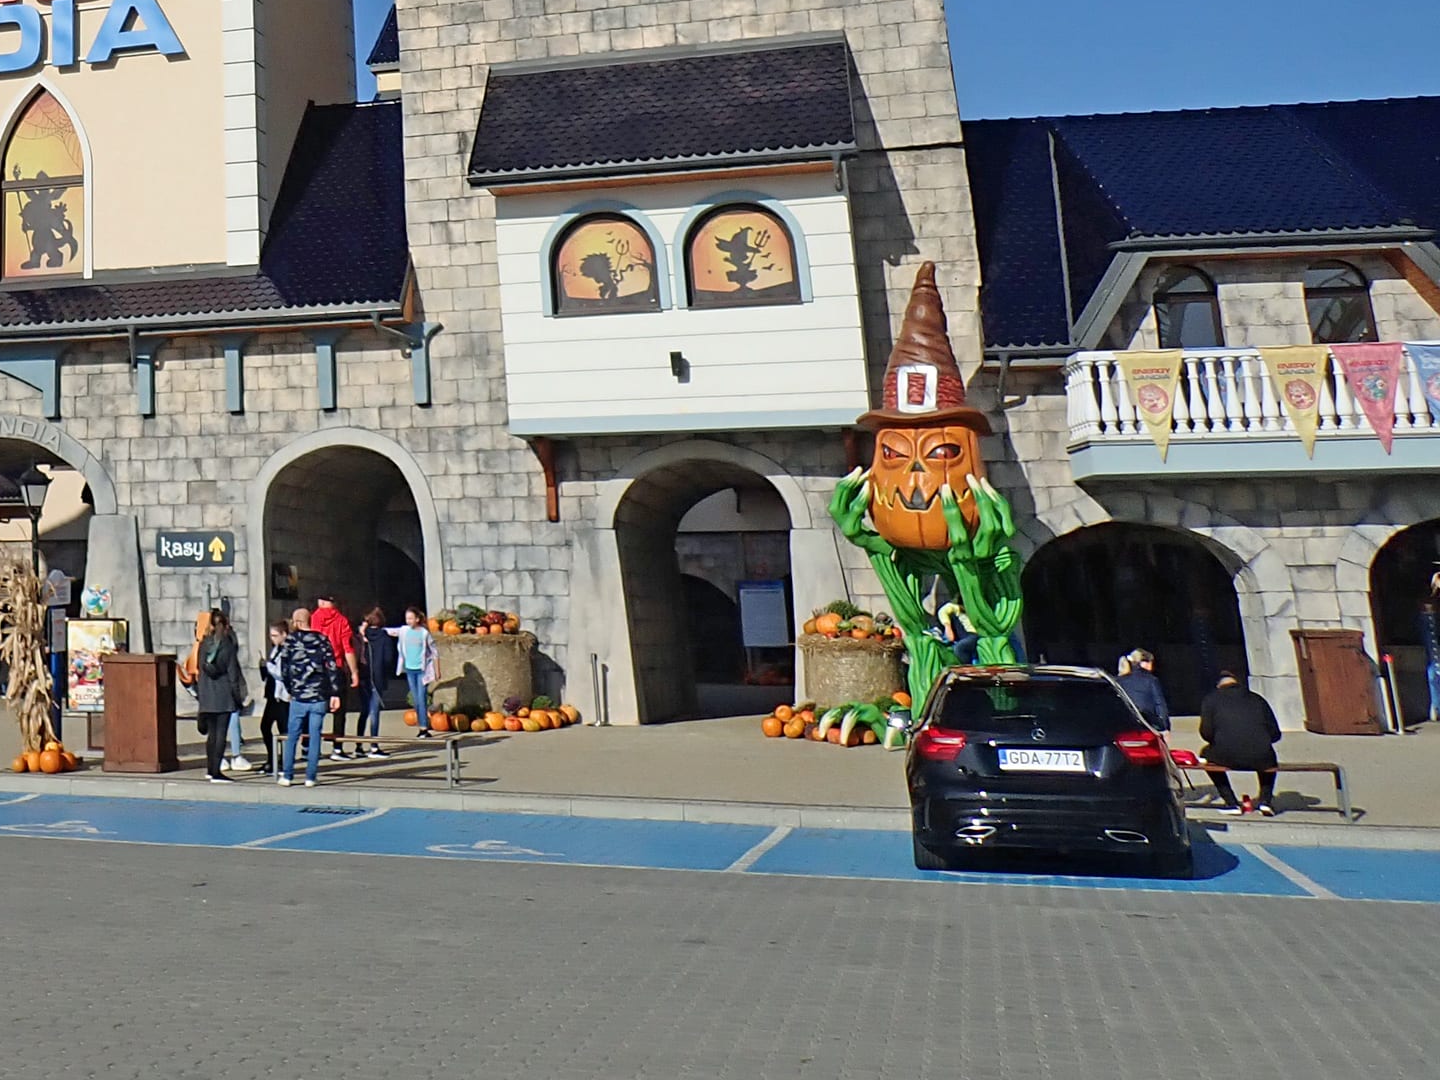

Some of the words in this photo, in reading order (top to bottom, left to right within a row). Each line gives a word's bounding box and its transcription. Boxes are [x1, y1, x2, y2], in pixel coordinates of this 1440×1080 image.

[160, 536, 204, 561] kasy
[1009, 751, 1040, 765] GDA
[1045, 752, 1081, 766] 77T2
